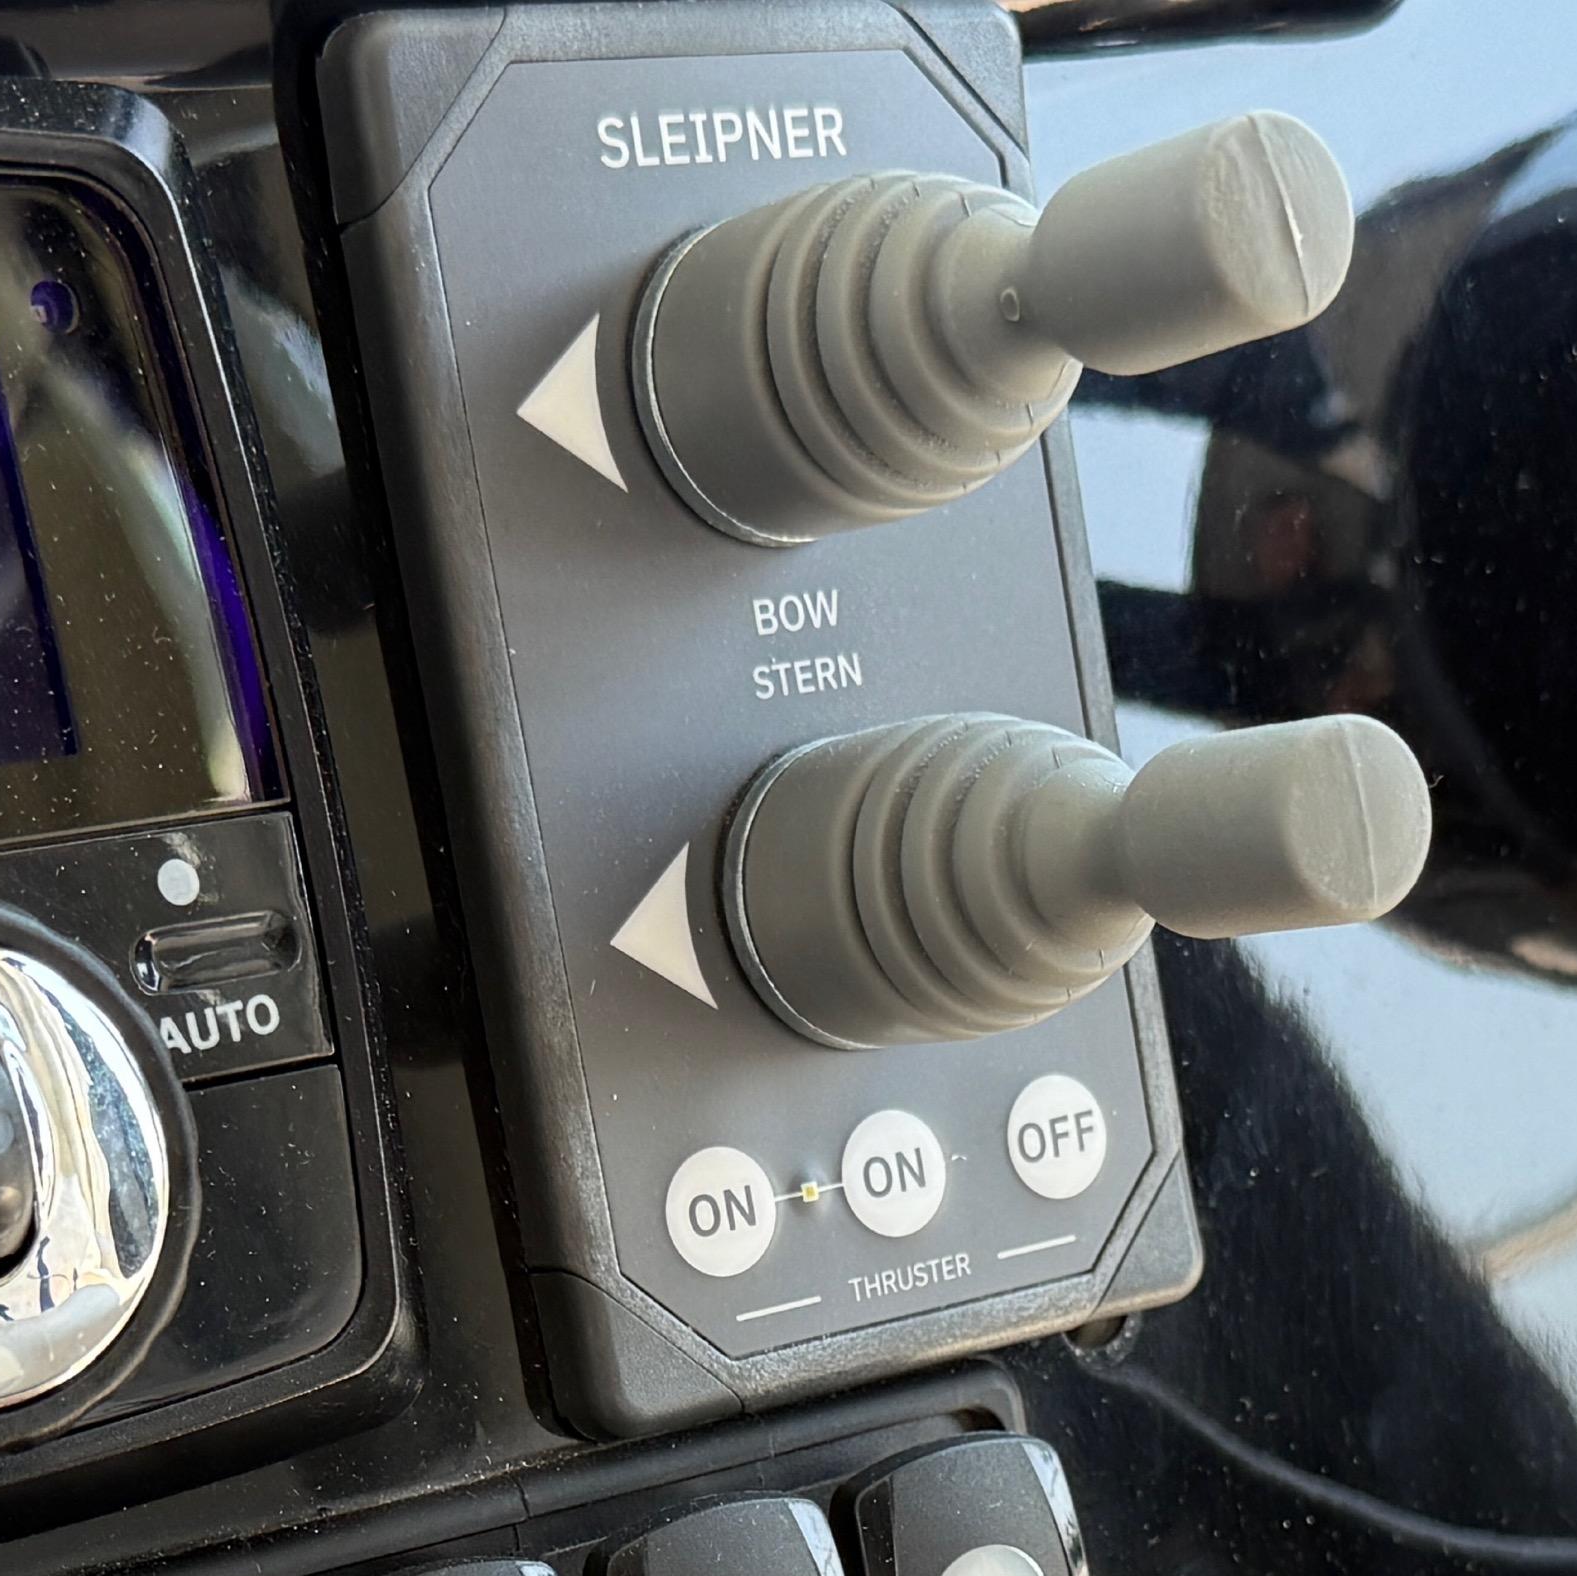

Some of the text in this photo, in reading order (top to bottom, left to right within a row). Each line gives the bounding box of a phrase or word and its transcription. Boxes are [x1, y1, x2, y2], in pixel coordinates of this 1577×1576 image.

[597, 106, 847, 168] SLEIPNER
[753, 589, 838, 635] BOW
[753, 653, 862, 699] STERN
[160, 994, 280, 1054] AUTO
[1018, 1110, 1095, 1163] OFF
[863, 1148, 927, 1198] ON
[688, 1185, 757, 1237] ON
[848, 1253, 971, 1302] THRUSTER
